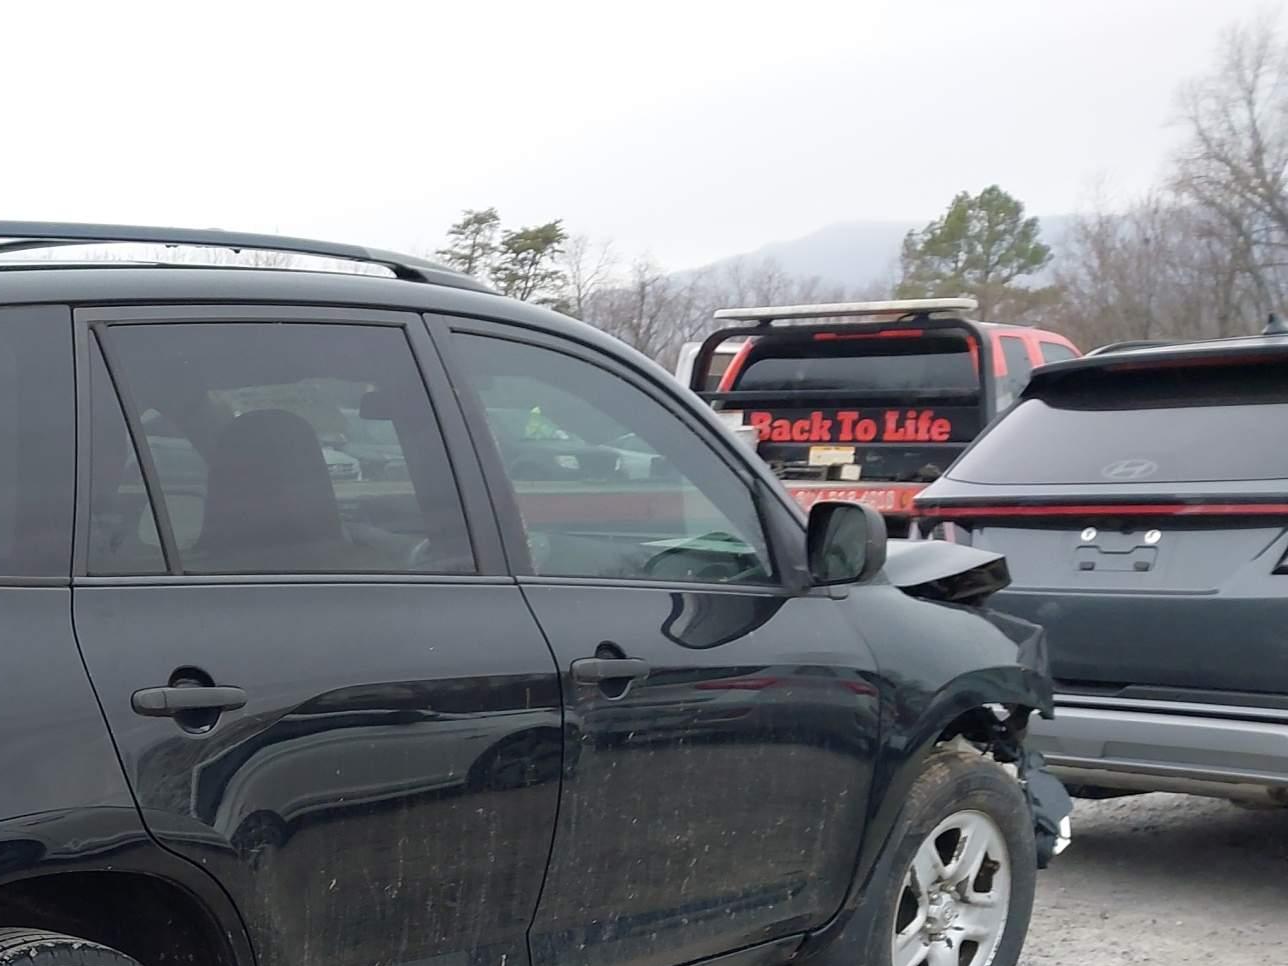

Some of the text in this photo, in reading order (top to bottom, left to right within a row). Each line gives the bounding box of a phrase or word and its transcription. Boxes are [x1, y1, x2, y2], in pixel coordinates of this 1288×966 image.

[750, 408, 952, 442] Back To Life
